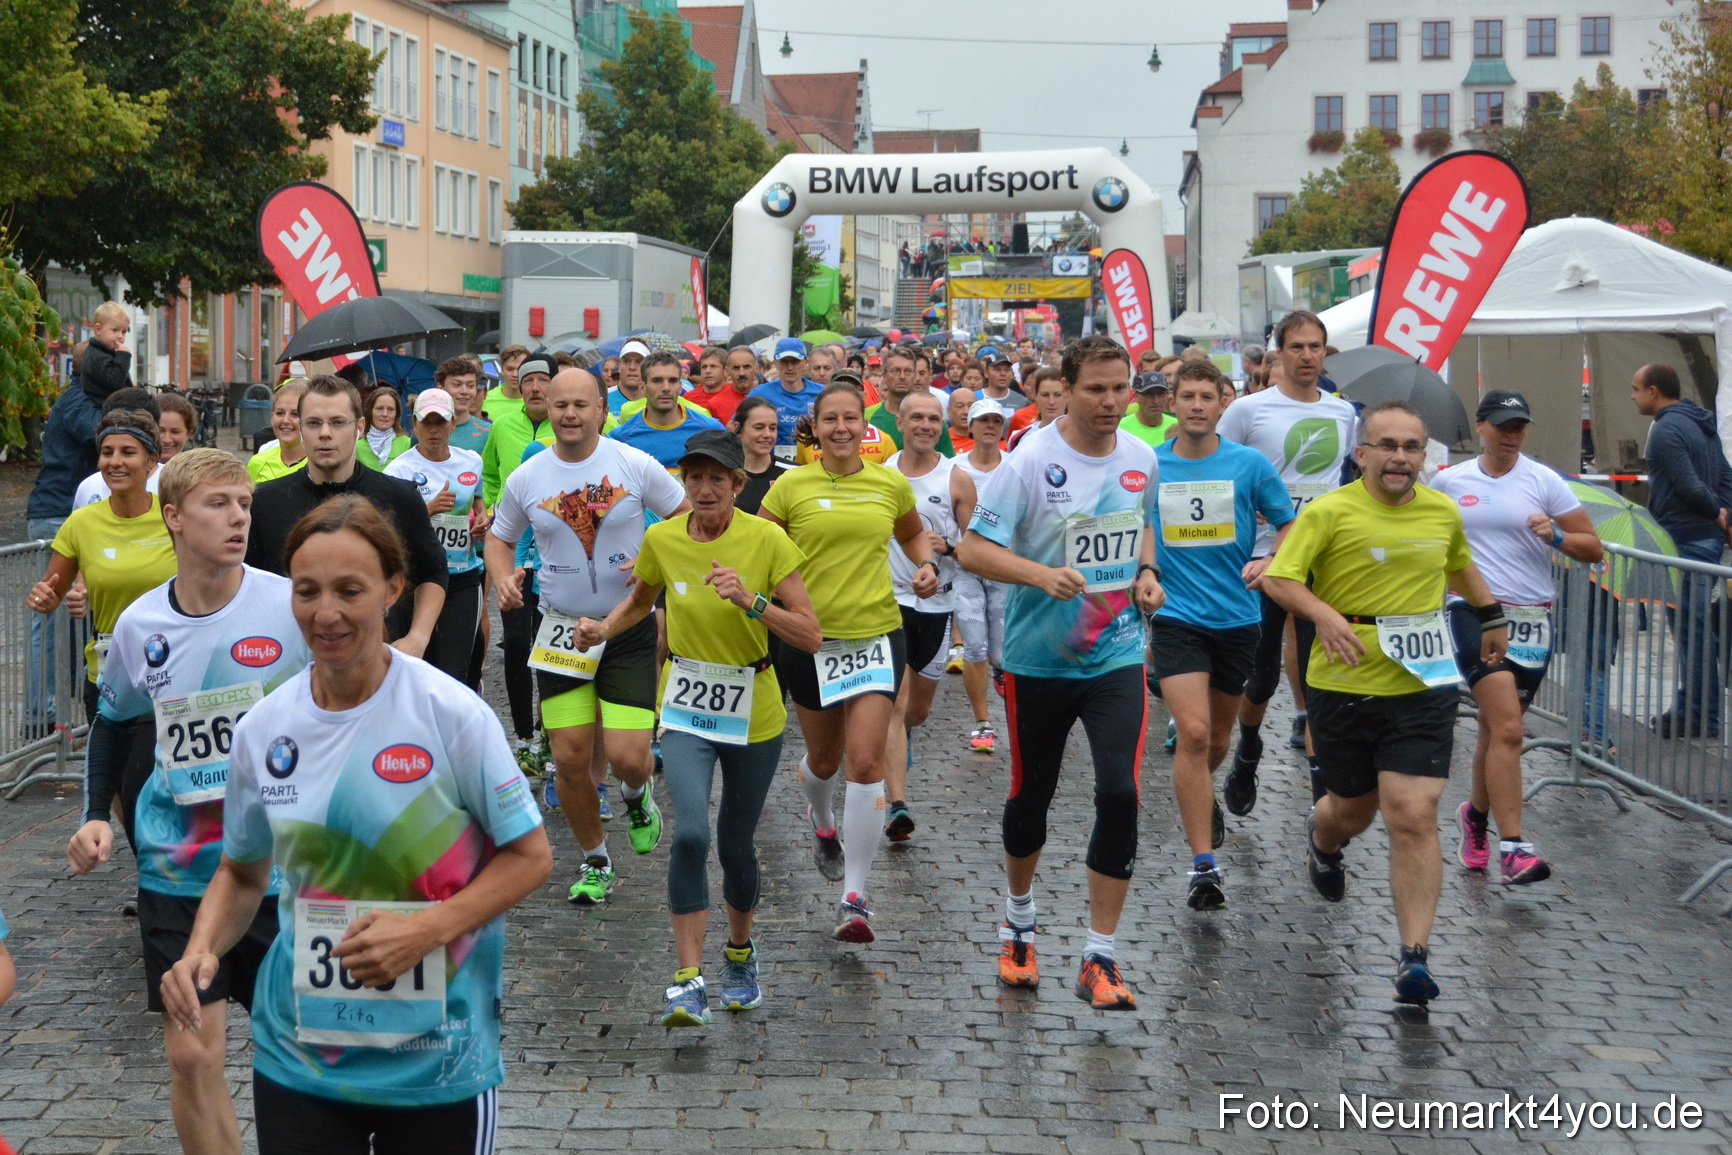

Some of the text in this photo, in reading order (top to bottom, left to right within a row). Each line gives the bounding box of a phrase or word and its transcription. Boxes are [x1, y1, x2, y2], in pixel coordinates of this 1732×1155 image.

[808, 164, 1080, 198] BMW Laufsport
[1384, 180, 1507, 362] REWE
[1004, 283, 1036, 294] ZIEL
[974, 504, 1000, 525] OCK
[1102, 512, 1137, 526] BOCK
[1190, 497, 1204, 522] 3
[1179, 527, 1217, 538] Michael
[1075, 529, 1138, 564] 2077
[1095, 567, 1124, 581] David
[549, 624, 590, 653] 23
[1507, 619, 1543, 644] 091
[238, 644, 277, 659] Hervis
[1388, 629, 1444, 660] 3001
[543, 652, 587, 670] Sebastian
[825, 643, 885, 682] 2354
[840, 674, 872, 691] Andrea
[196, 687, 252, 708] BOCK
[672, 677, 745, 713] 2287
[691, 715, 718, 730] Gabi
[167, 711, 247, 763] 256
[381, 754, 426, 773] Hervis
[261, 785, 299, 797] PARTL
[306, 915, 348, 926] NeuerMarkt
[334, 1002, 375, 1027] Rita
